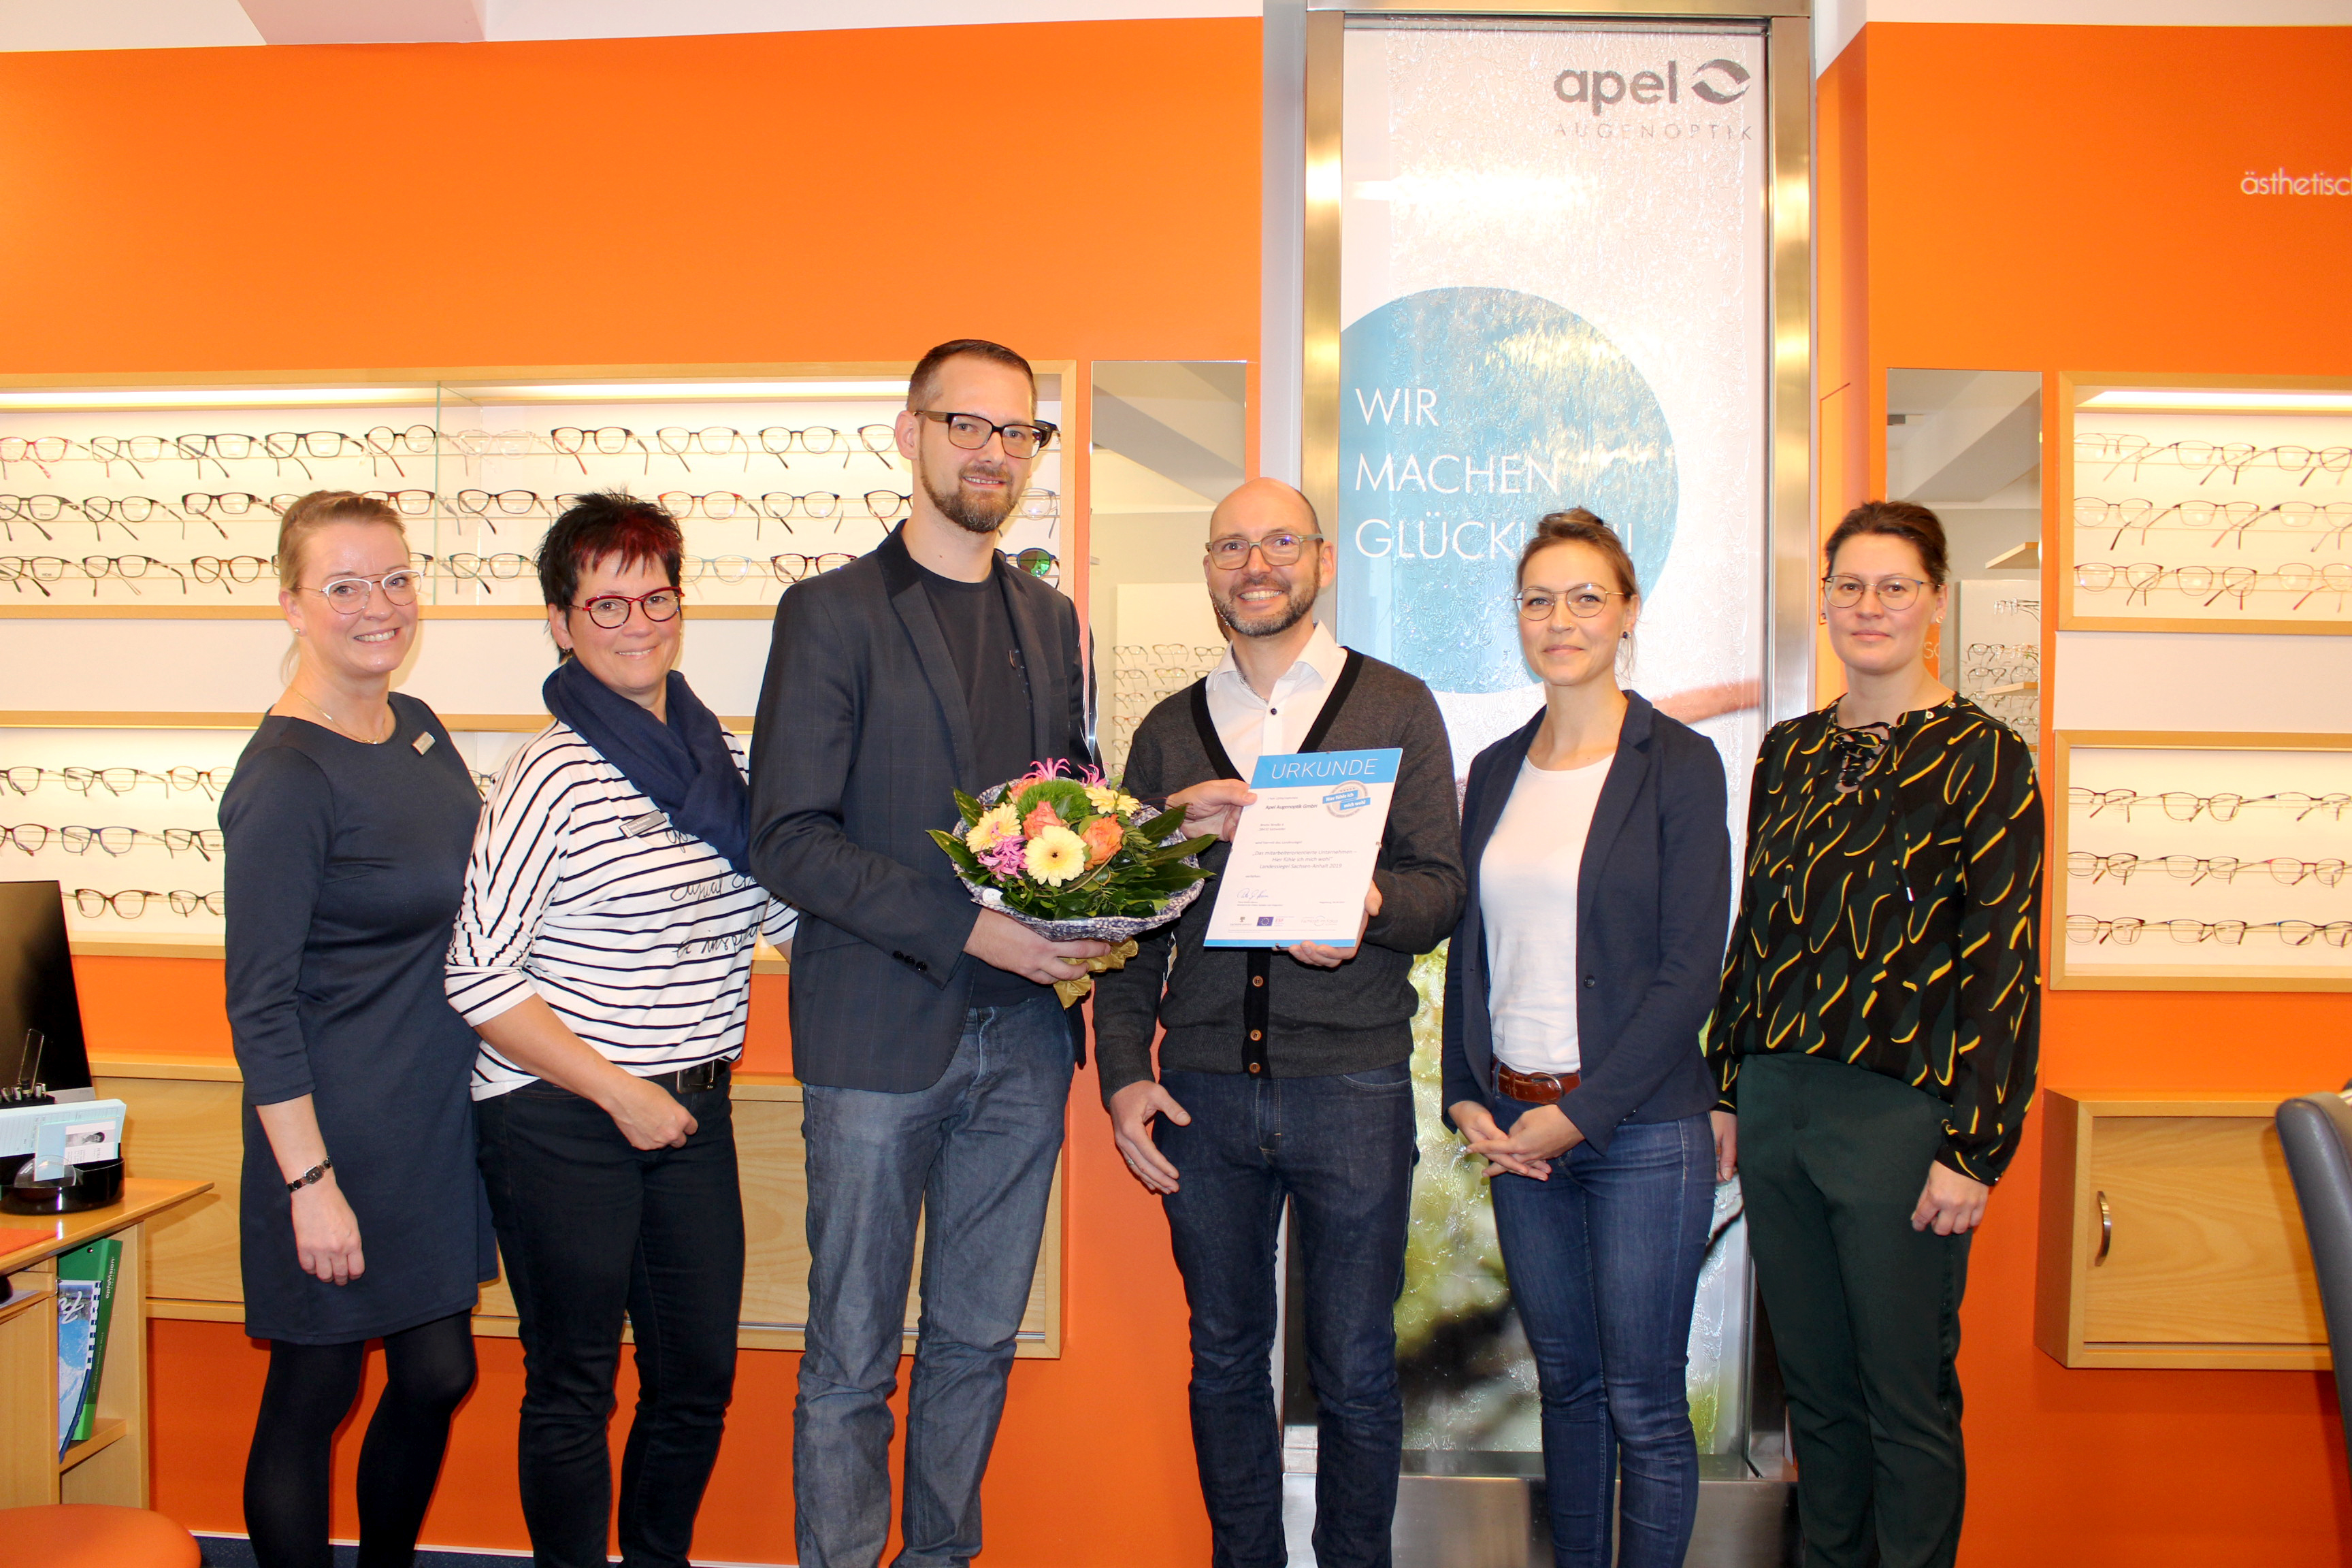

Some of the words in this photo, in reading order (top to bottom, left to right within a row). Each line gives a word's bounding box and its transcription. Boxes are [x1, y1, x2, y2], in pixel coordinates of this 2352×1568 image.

[1554, 59, 1678, 116] apel
[1554, 122, 1753, 141] AUGENOPTIK
[2240, 166, 2352, 196] ästhetisc
[1354, 387, 1439, 427] WIR
[1355, 453, 1561, 495] MACHEN
[1271, 758, 1378, 780] URKUNDE
